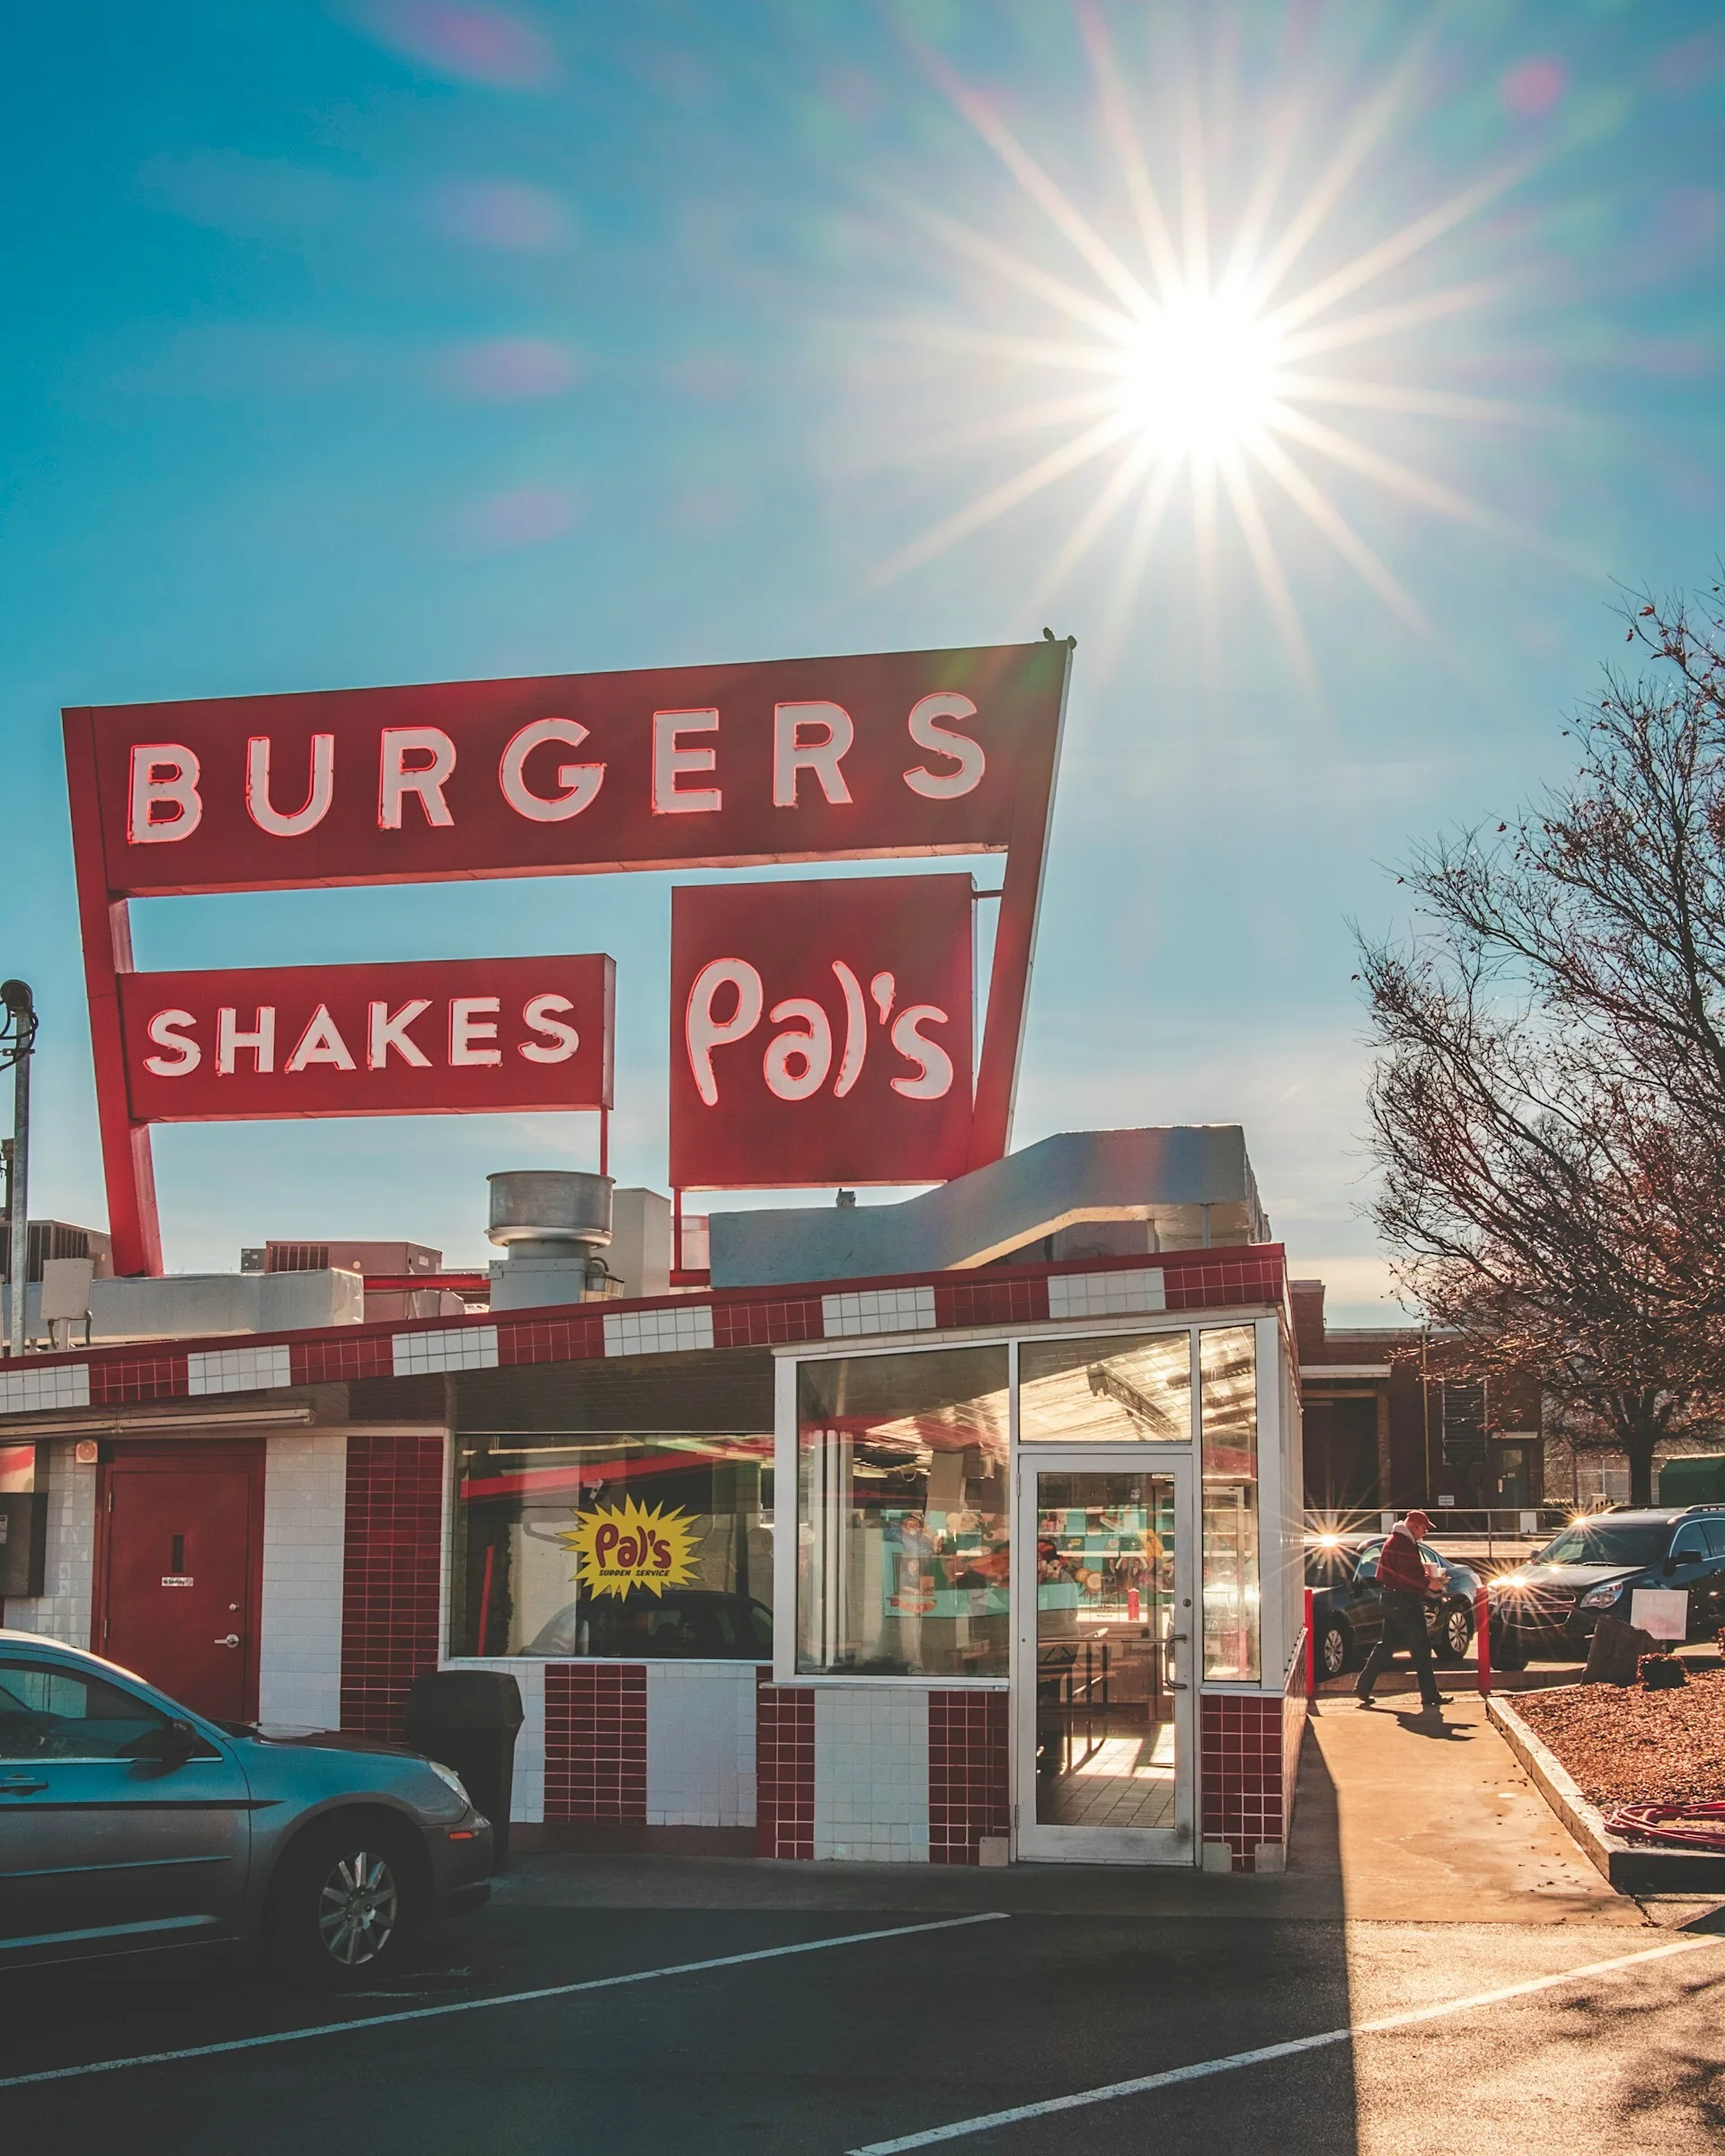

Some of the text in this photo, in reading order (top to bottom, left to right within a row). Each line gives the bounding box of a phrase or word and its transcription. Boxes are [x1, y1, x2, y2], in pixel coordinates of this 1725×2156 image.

[127, 690, 987, 845] BURGERS
[141, 992, 581, 1079] SHAKES
[685, 956, 955, 1109] Pal's
[595, 1523, 672, 1568] Pal's
